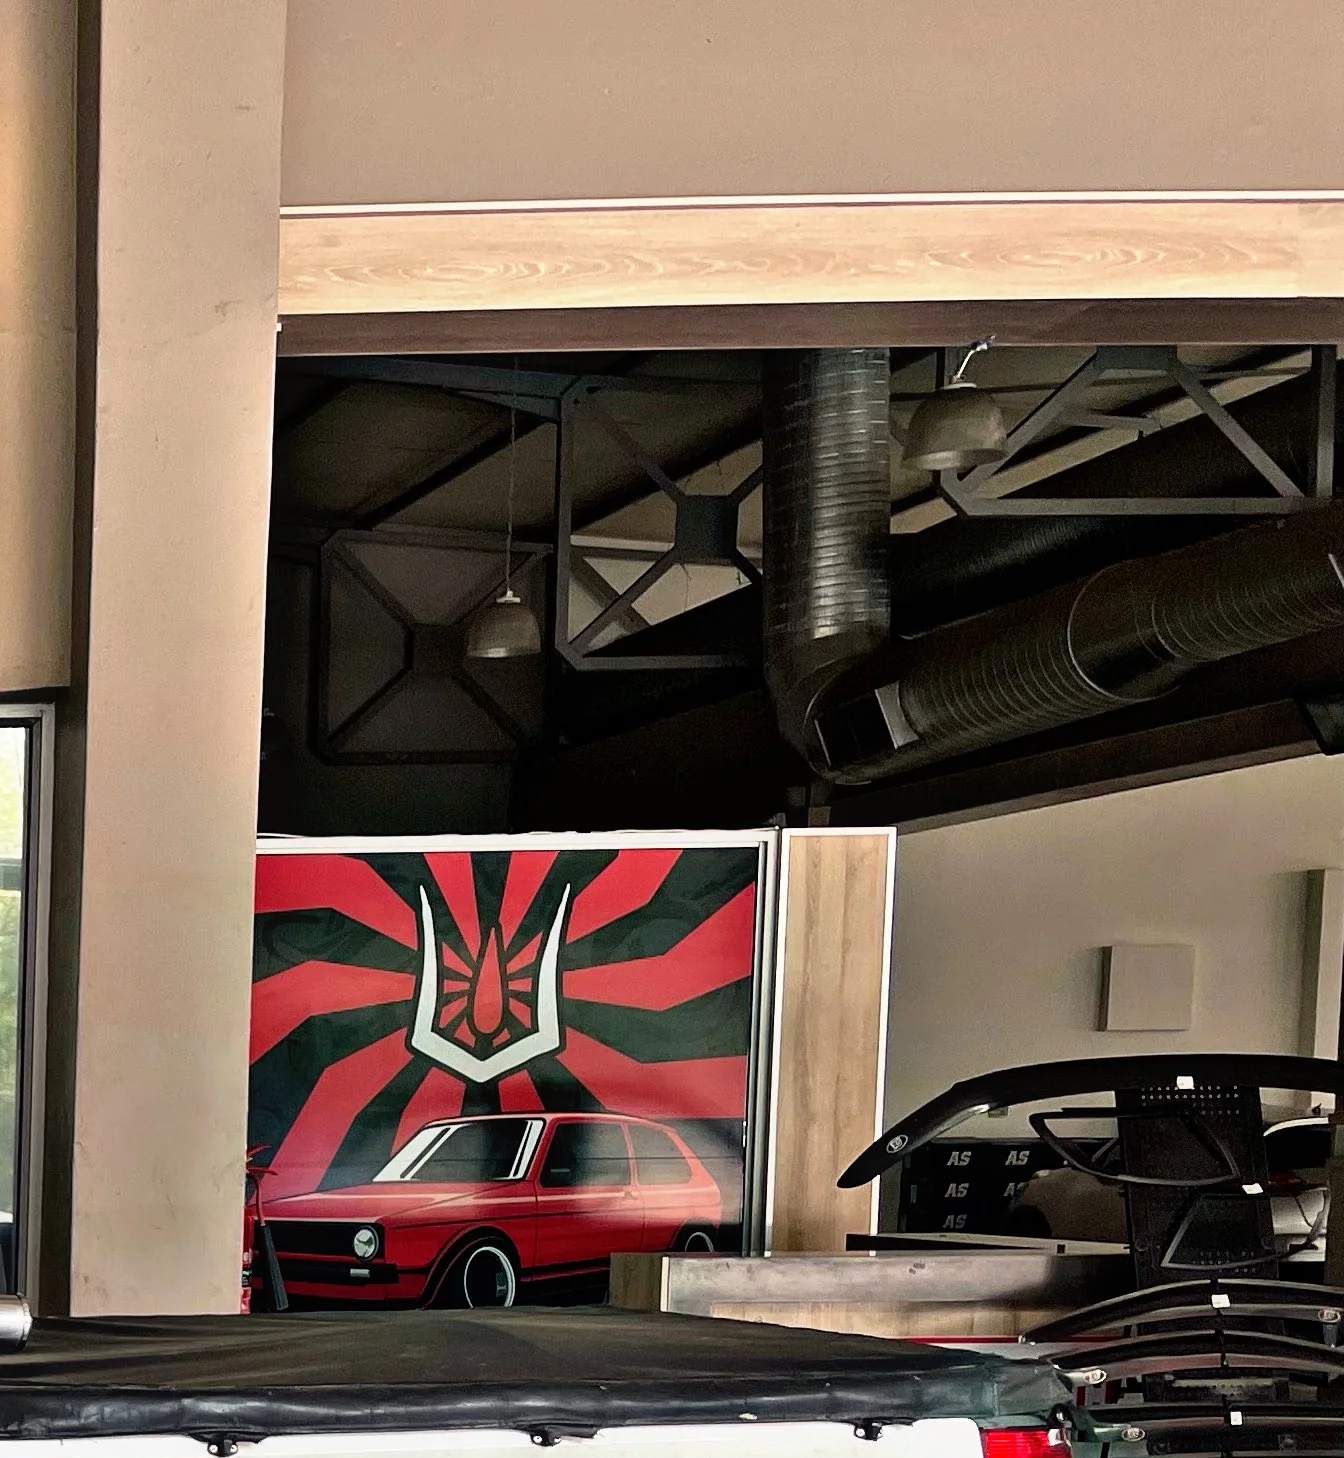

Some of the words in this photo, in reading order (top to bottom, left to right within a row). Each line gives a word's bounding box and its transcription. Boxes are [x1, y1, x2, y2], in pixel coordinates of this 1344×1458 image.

[946, 1151, 972, 1167] AS
[1005, 1150, 1031, 1166] AS
[944, 1182, 970, 1198] AS
[942, 1213, 968, 1229] AS
